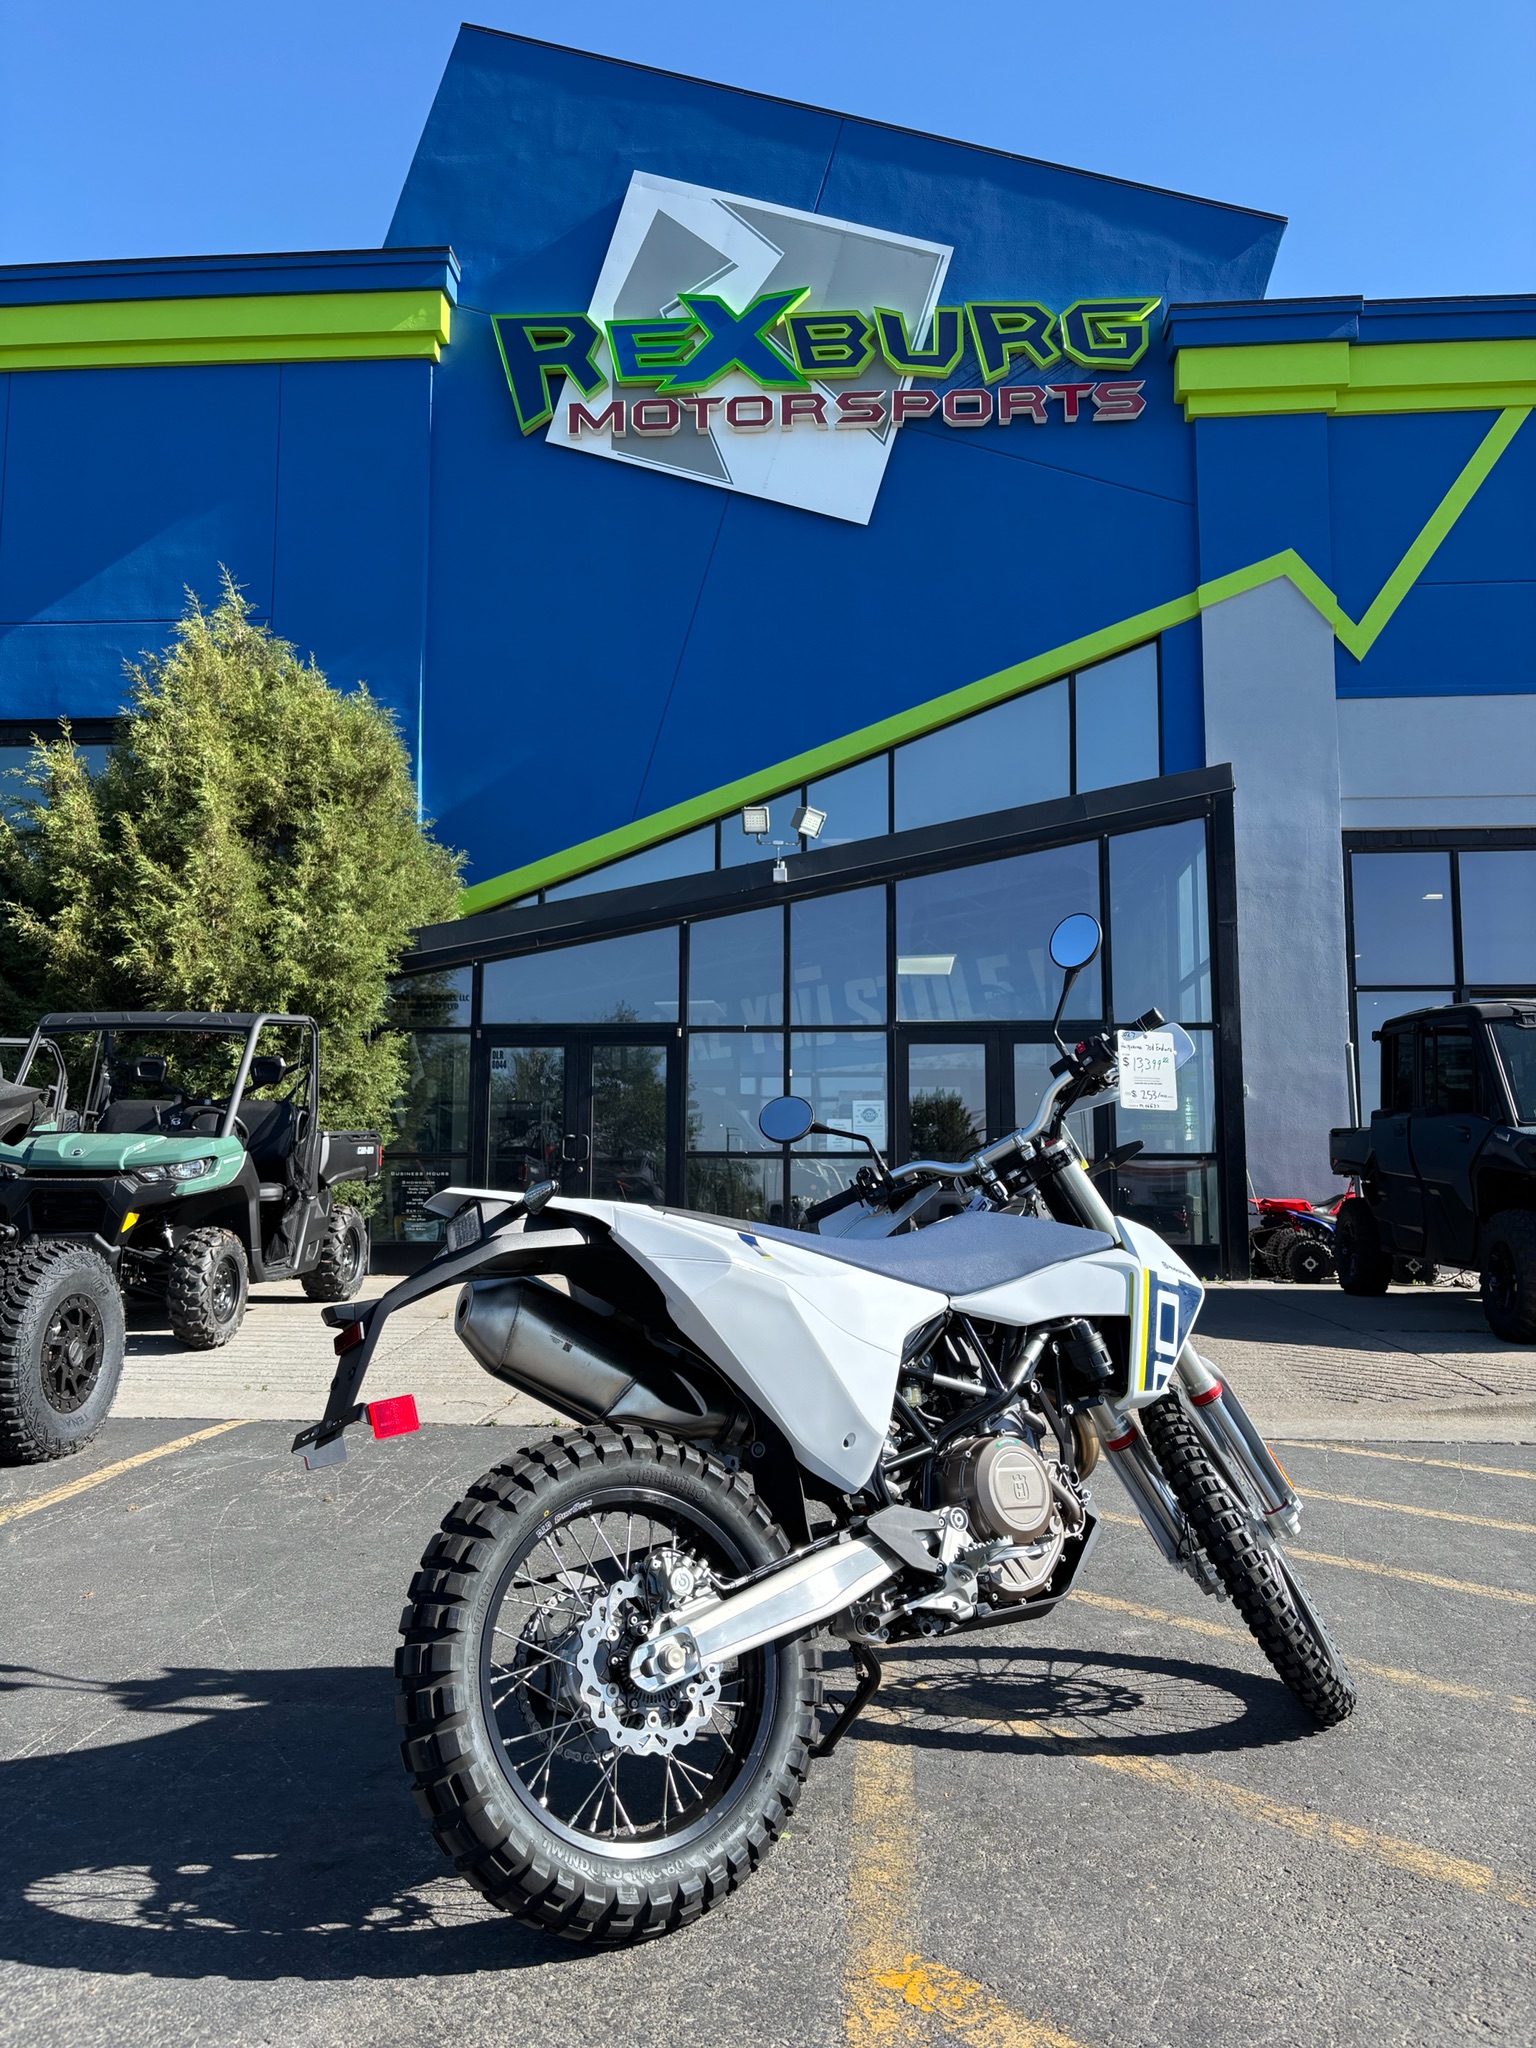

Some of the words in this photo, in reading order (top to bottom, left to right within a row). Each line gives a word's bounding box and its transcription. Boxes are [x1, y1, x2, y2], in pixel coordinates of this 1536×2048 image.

[491, 286, 1163, 436] REXBURG
[567, 380, 1147, 440] MOTORSPORTS
[491, 1060, 507, 1069] 8044
[492, 1050, 504, 1060] DLR
